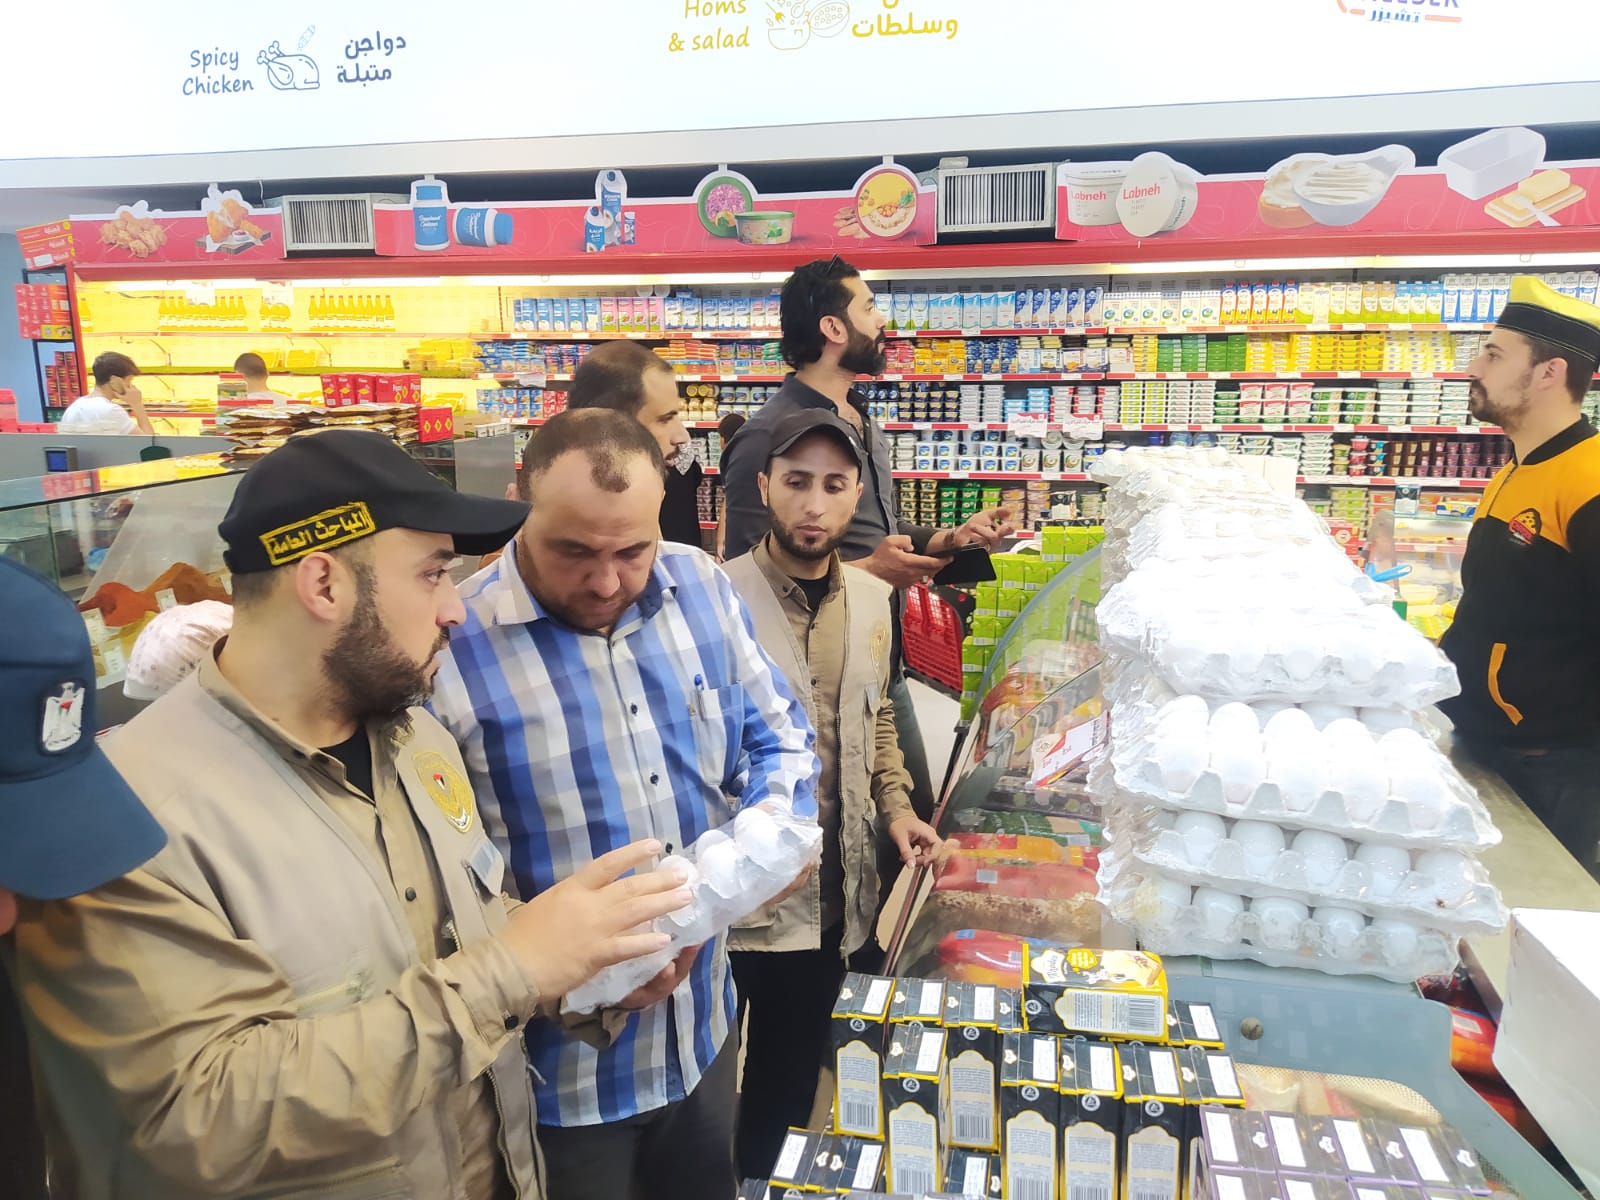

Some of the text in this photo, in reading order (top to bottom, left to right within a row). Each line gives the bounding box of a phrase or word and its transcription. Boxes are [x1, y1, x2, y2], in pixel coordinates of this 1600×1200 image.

[685, 0, 747, 18] Homs
[668, 25, 750, 52] & salad
[851, 12, 959, 40] وسلطات
[344, 30, 407, 60] دواجن
[190, 47, 239, 73] Spicy
[182, 74, 254, 96] Chicken
[336, 63, 392, 87] متبلة
[1071, 191, 1107, 201] Labneh
[1123, 183, 1161, 200] Labneh
[268, 510, 368, 555] المباحث العامة
